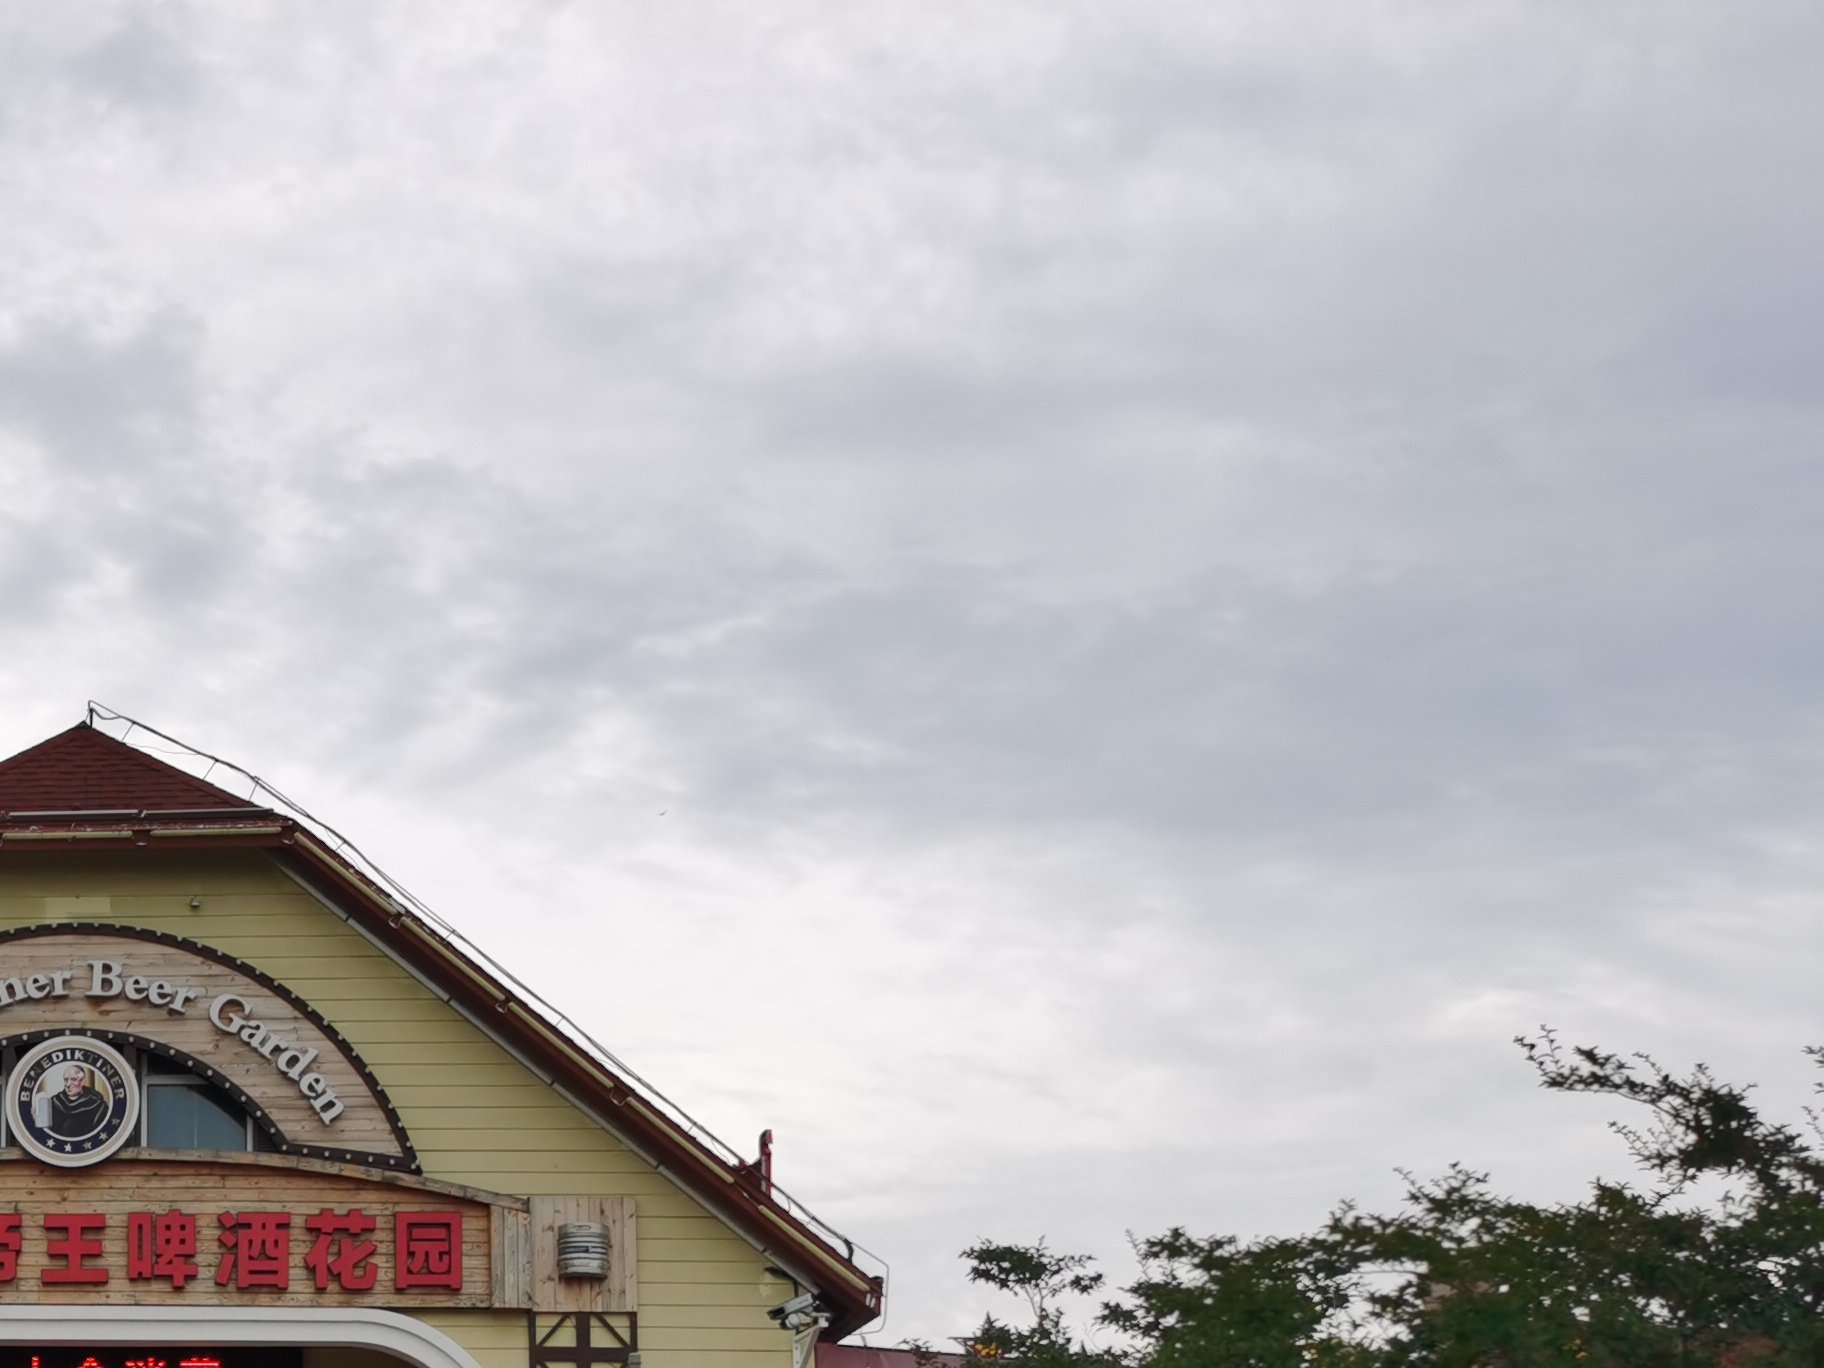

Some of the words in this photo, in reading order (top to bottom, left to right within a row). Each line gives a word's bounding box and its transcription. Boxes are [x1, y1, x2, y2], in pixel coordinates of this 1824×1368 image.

[20, 1049, 125, 1102] BENEDIKTINER
[85, 959, 201, 1015] Beer
[208, 993, 347, 1126] Garden
